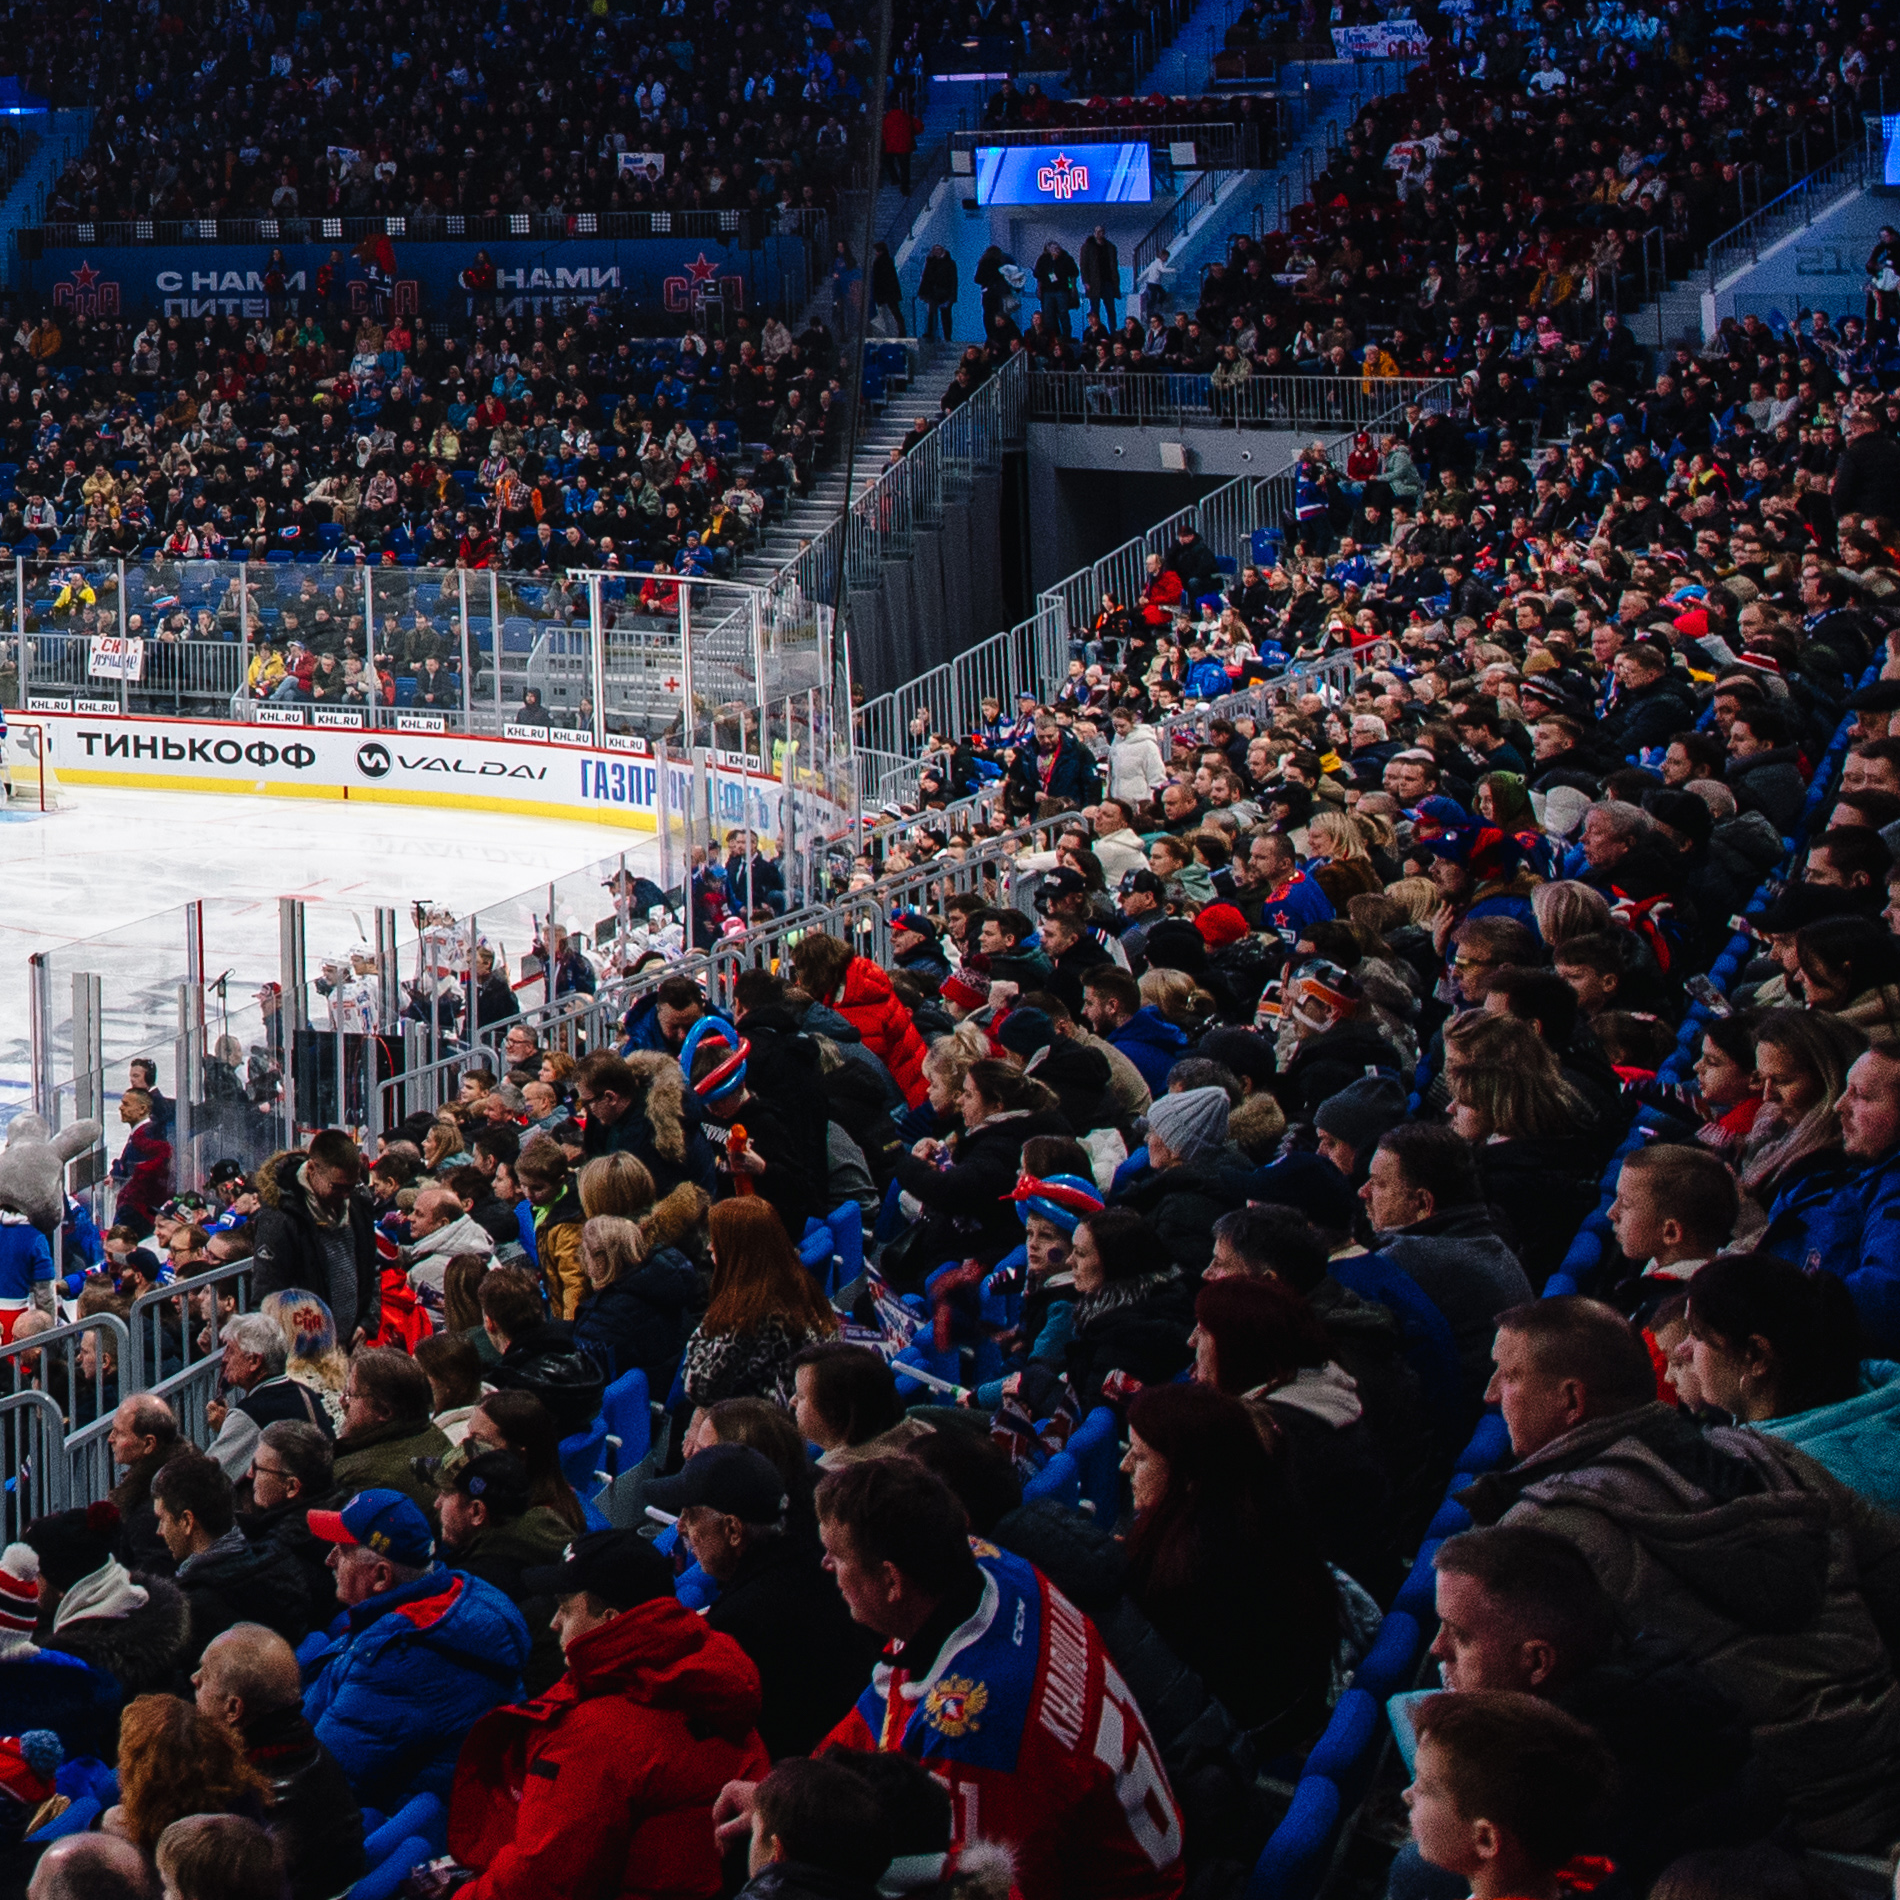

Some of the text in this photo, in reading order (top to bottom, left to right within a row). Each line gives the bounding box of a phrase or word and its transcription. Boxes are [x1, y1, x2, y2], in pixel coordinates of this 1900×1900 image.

[155, 270, 184, 293] С
[400, 718, 443, 731] KHL.RU
[507, 727, 546, 741] KHL.RU
[76, 731, 317, 770] ТИНЬКОФФ
[398, 754, 548, 781] VALDAI
